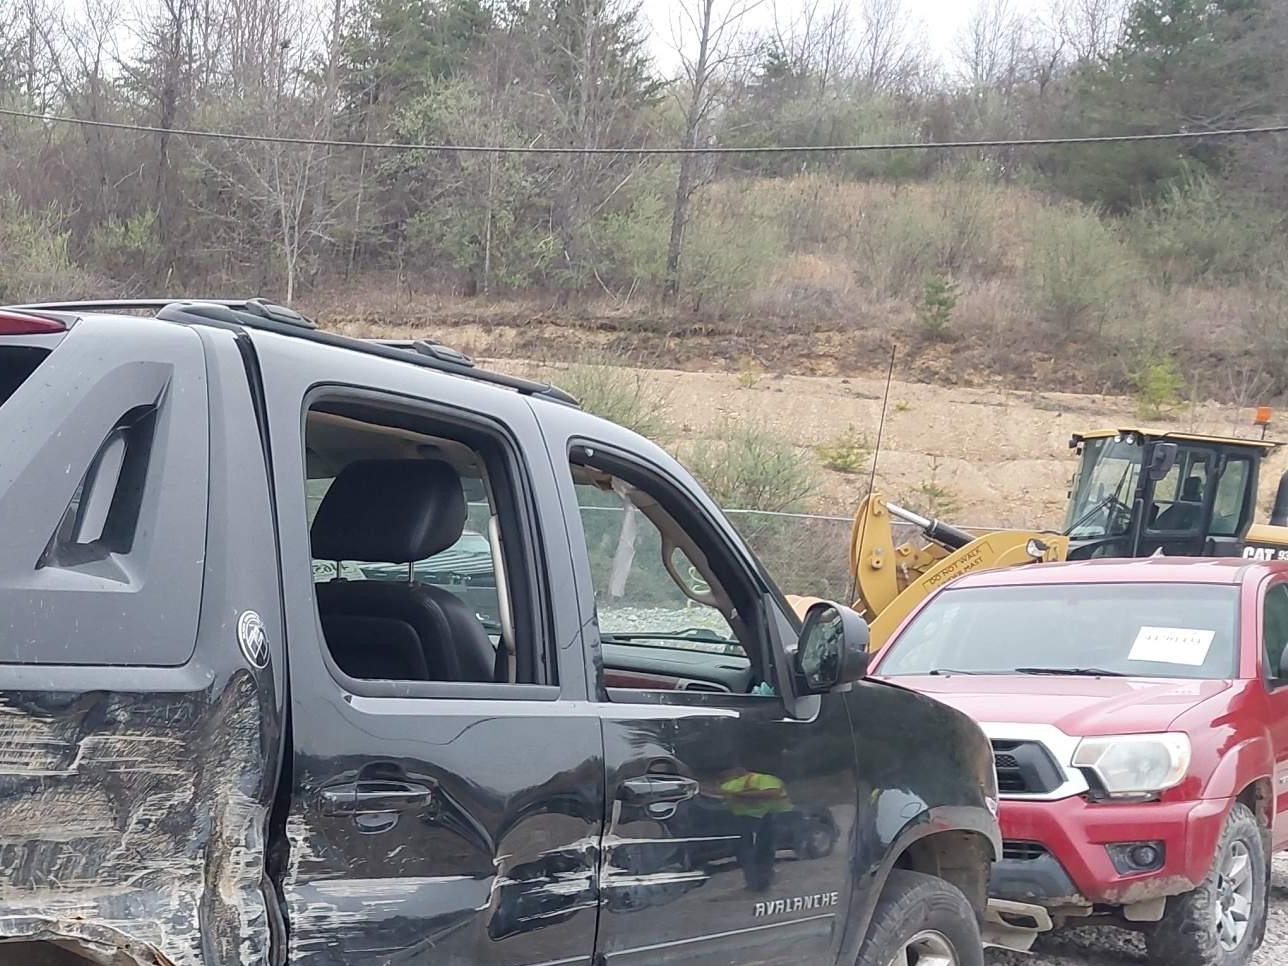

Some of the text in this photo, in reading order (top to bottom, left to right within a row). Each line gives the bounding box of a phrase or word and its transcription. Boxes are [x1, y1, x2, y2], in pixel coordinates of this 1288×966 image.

[943, 562, 958, 576] NOT
[960, 548, 982, 564] WALK
[1243, 546, 1275, 560] CAT
[755, 891, 839, 917] AVALANCHE
